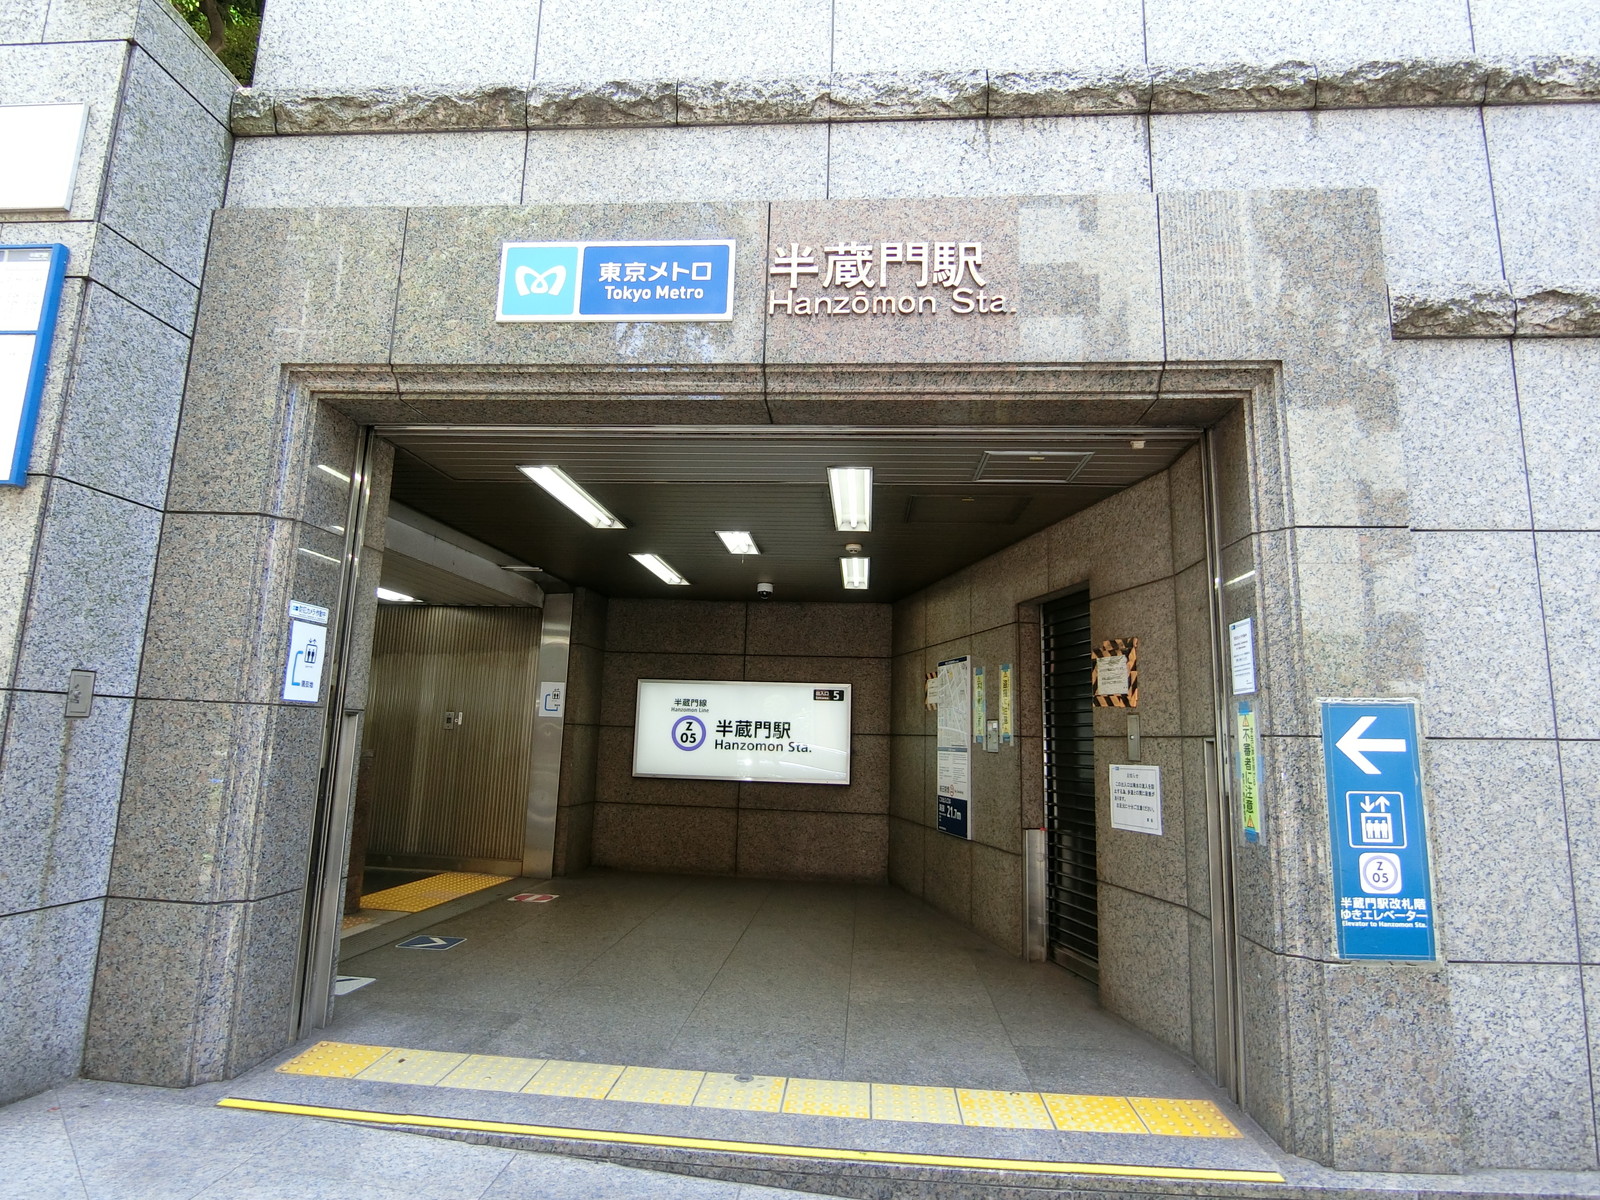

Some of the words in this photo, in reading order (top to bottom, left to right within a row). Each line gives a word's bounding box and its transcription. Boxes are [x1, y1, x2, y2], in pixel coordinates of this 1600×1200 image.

[769, 241, 987, 289] 半蔵門駅
[598, 261, 712, 283] 東京メトロ
[604, 285, 652, 303] Tokyo
[656, 285, 704, 300] Metro
[768, 290, 937, 316] Hanzōmon
[951, 288, 1018, 315] Sta.
[833, 690, 840, 700] 5
[674, 698, 707, 707] 半蔵門線
[685, 721, 693, 731] Z
[715, 719, 791, 740] 半蔵門駅
[680, 732, 697, 744] 05
[714, 739, 783, 752] Hanzomon
[788, 741, 812, 753] Sta.
[946, 805, 962, 821] 21.7m
[1376, 861, 1383, 871] Z
[1372, 872, 1389, 883] 05
[1340, 897, 1426, 910] 半蔵門駅改札階
[1340, 909, 1428, 921] ゆきエレベーター
